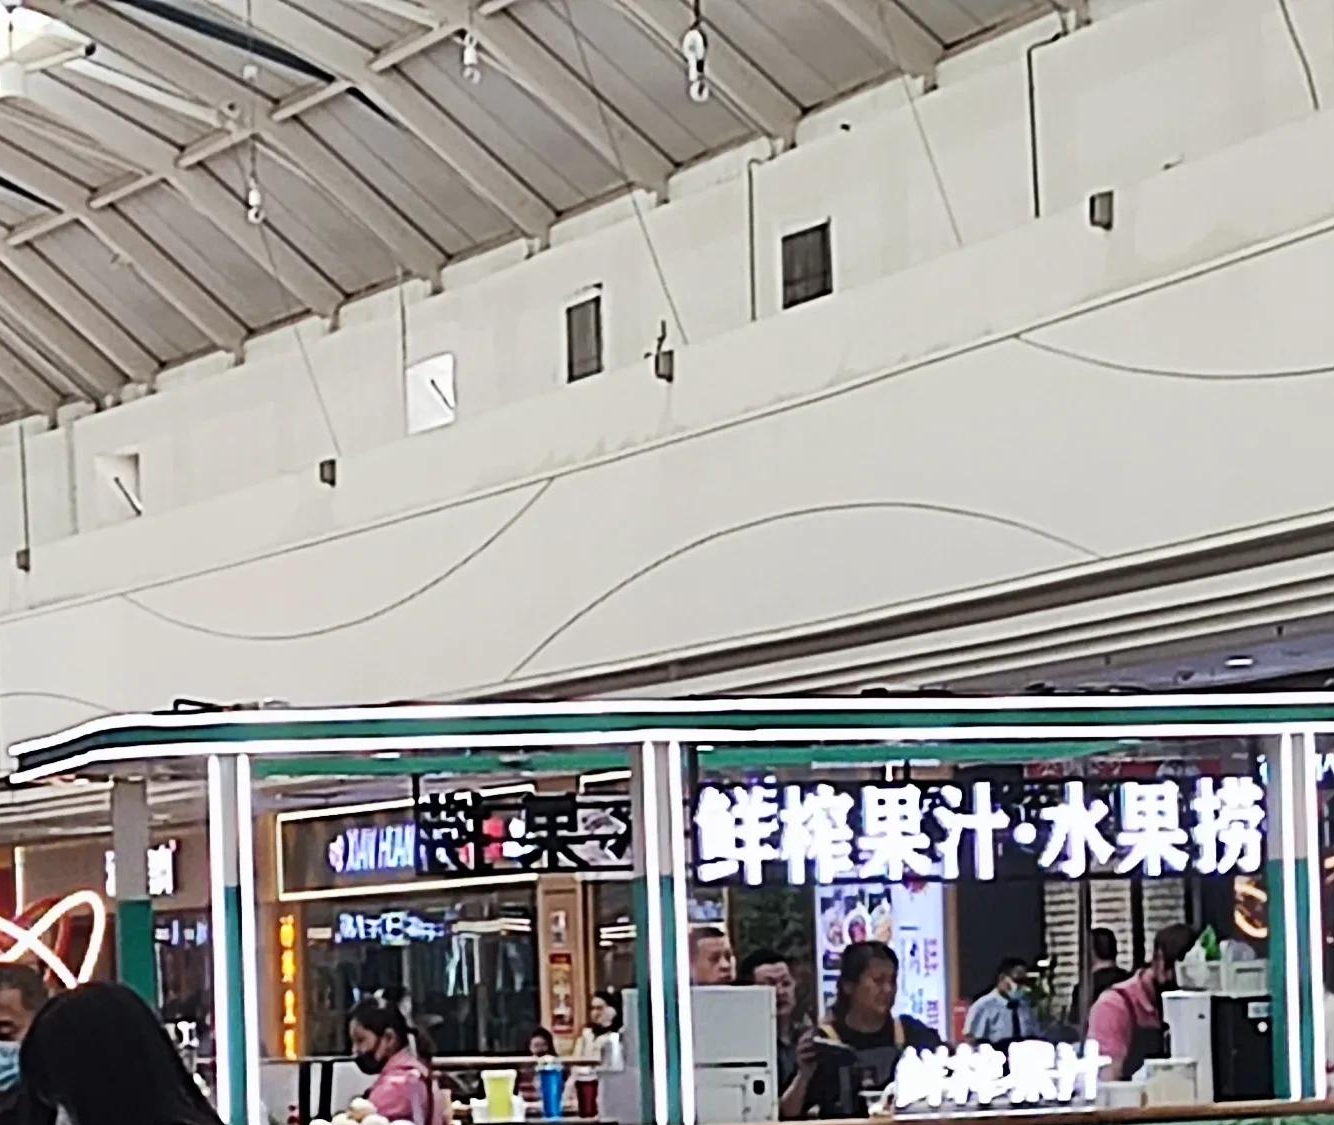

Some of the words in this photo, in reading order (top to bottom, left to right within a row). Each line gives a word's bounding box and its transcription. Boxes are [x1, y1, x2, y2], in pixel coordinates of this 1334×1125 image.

[693, 780, 1265, 886] 鲜榨果汁·水果捞
[894, 1039, 1112, 1109] 鲜榨果汁
